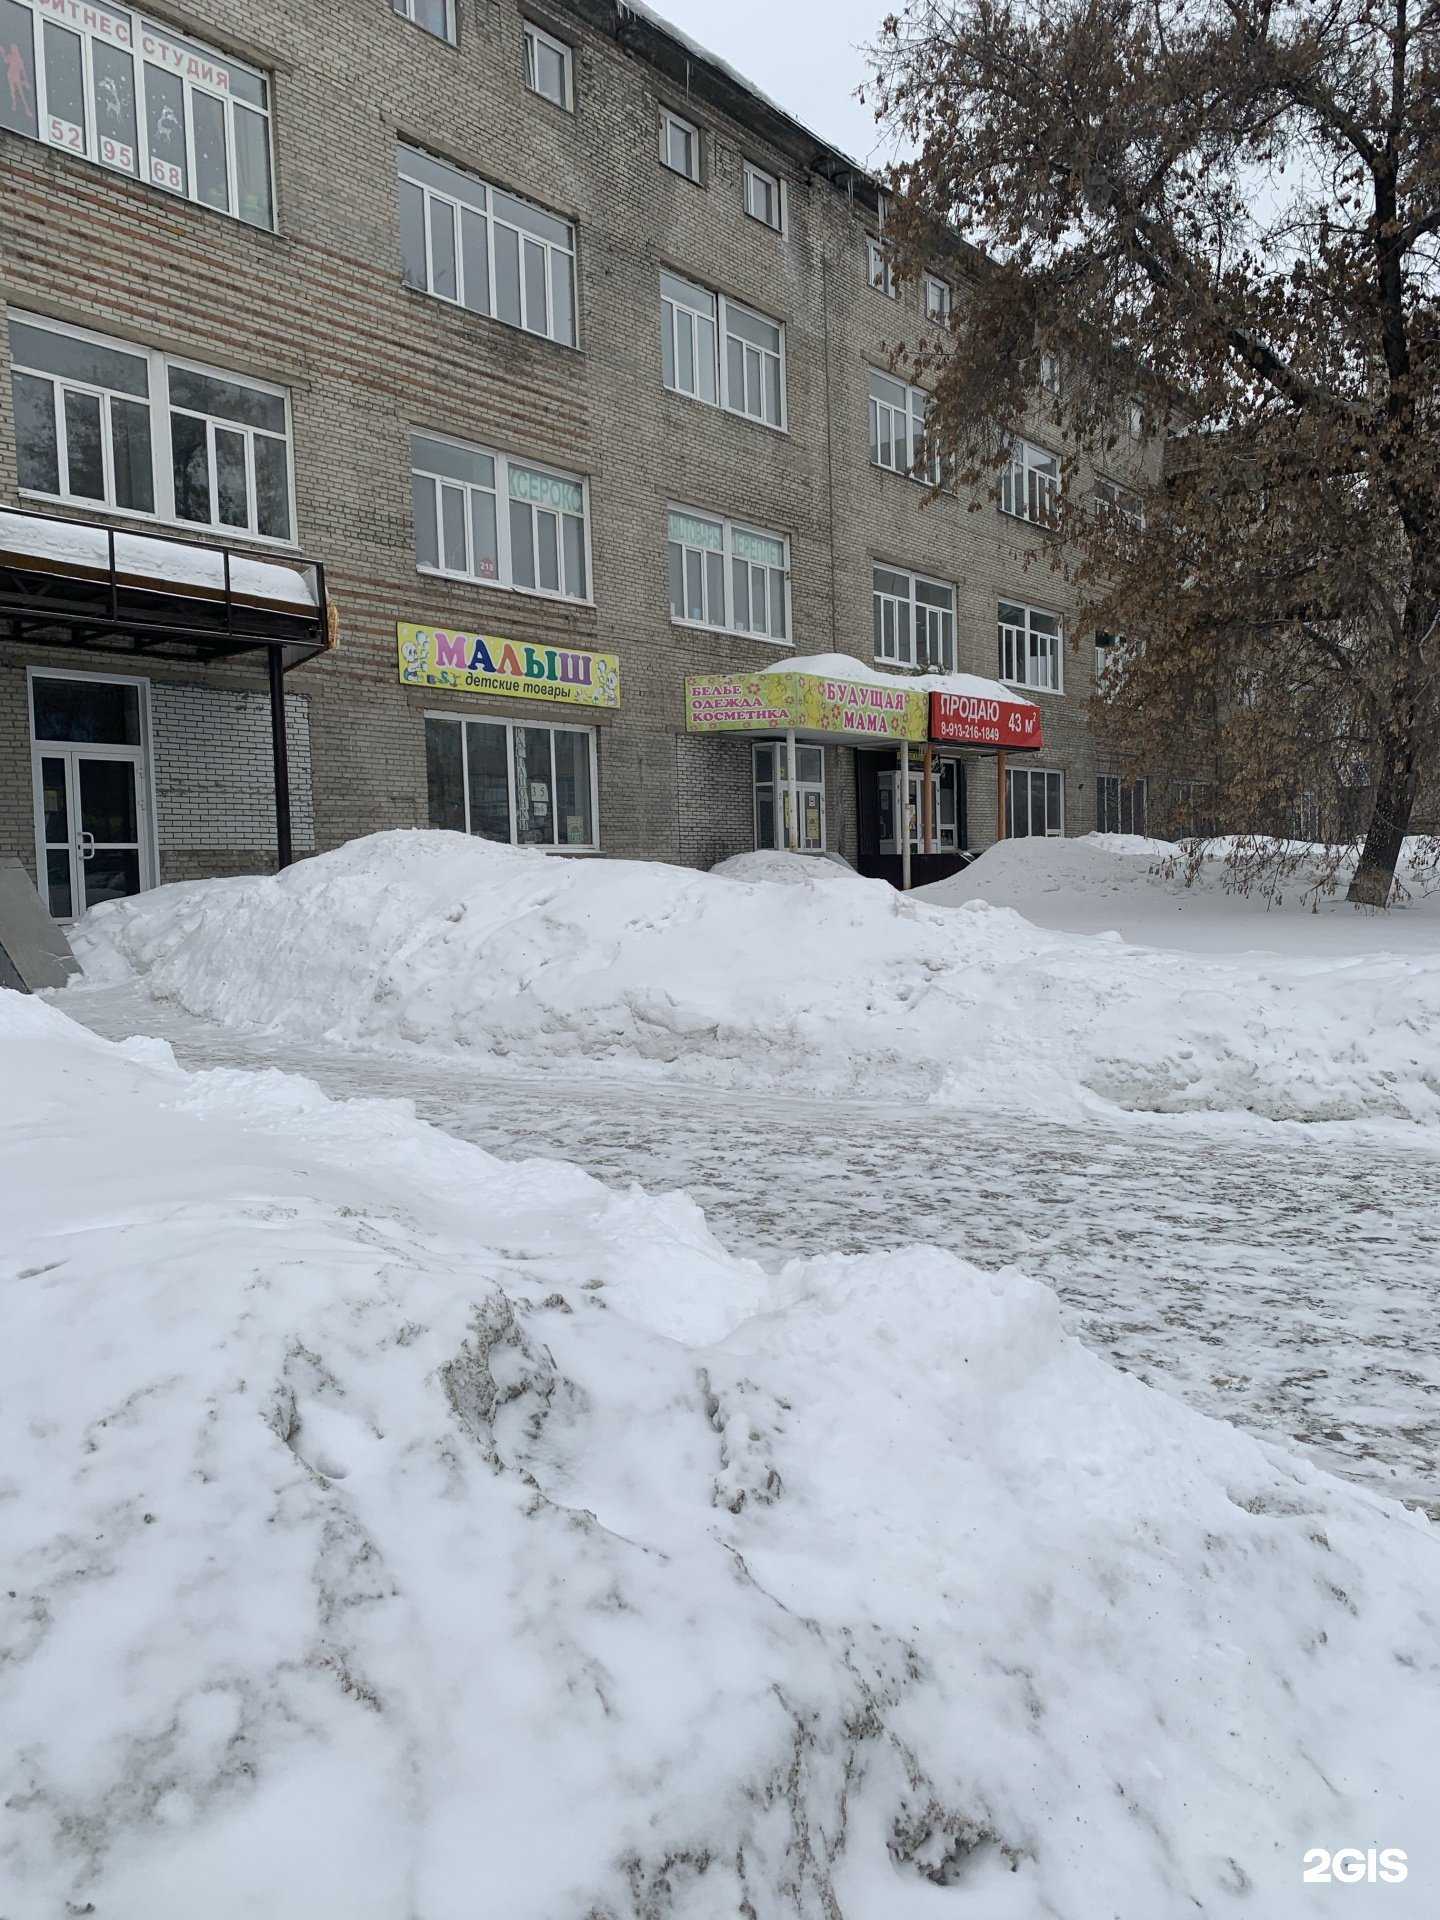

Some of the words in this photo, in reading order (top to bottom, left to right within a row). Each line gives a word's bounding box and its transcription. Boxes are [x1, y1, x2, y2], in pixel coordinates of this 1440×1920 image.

[40, 0, 129, 42] ИТНЕС
[142, 38, 229, 89] СТУДИЯ
[50, 120, 81, 147] 52
[103, 141, 131, 167] 95
[153, 160, 181, 187] 68
[434, 632, 593, 685] МАЛЫШ
[465, 672, 520, 692] детские
[522, 681, 571, 698] товары
[691, 685, 742, 697] БЕЛЬЕ
[826, 682, 905, 711] БУДУЩАЯ
[691, 697, 763, 710] ОДЕЖДА
[940, 694, 1000, 723] ПРОДАЮ
[843, 711, 888, 733] МАМА
[940, 721, 1000, 741] 8-913-216-1849
[1008, 712, 1022, 733] 43
